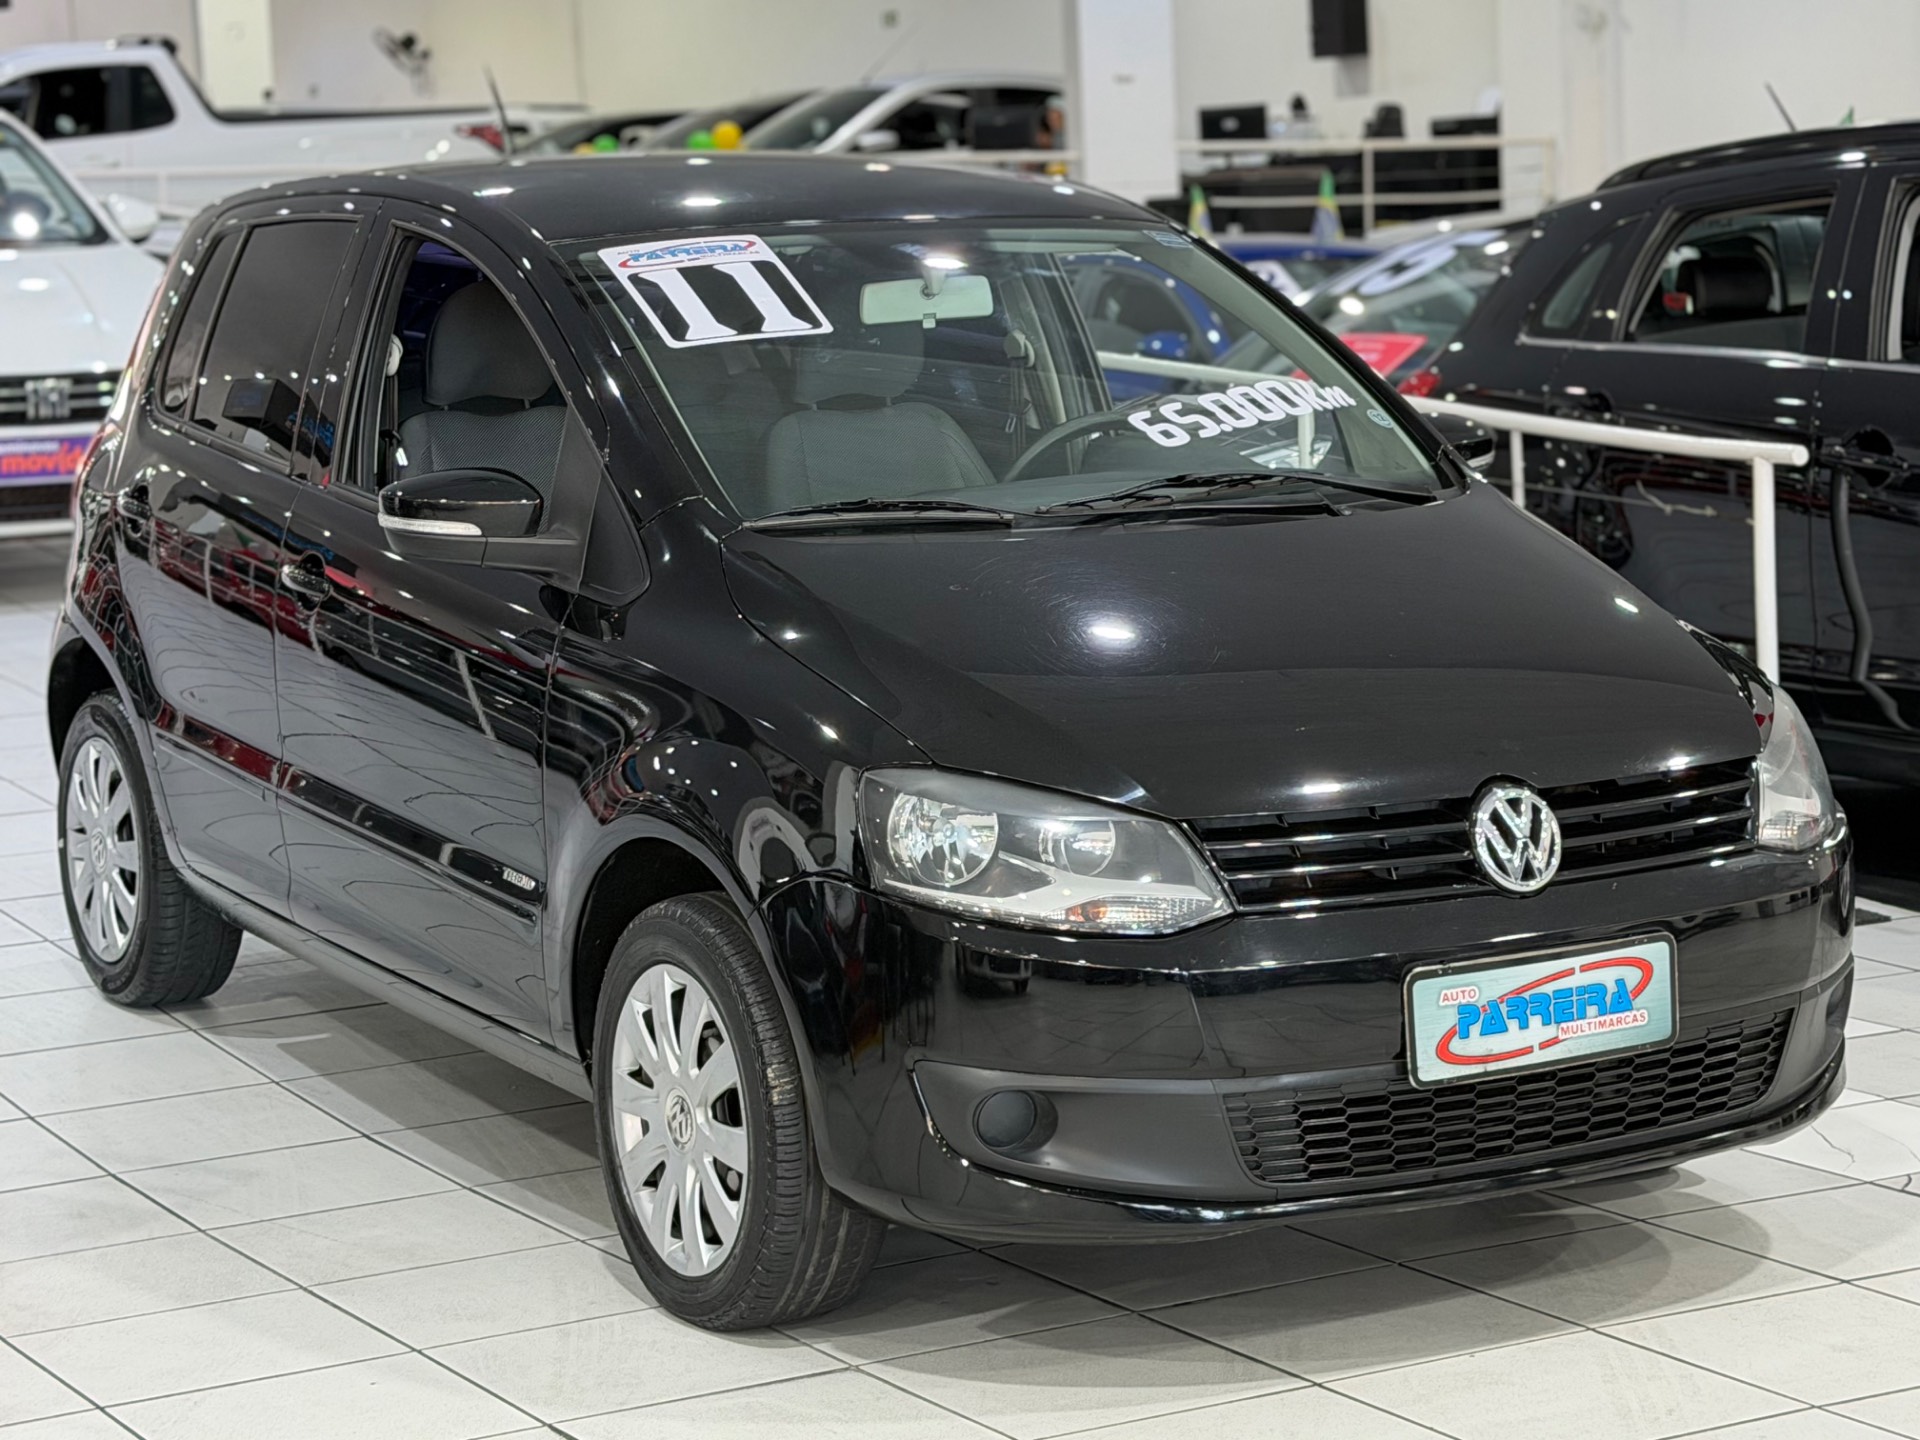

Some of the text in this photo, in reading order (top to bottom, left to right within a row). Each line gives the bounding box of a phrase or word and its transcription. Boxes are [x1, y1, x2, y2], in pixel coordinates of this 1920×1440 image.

[637, 261, 813, 341] 11
[1441, 988, 1477, 1003] AUTO
[1457, 978, 1633, 1040] PARREIRA
[1559, 1011, 1647, 1038] MULTIMARCAS
